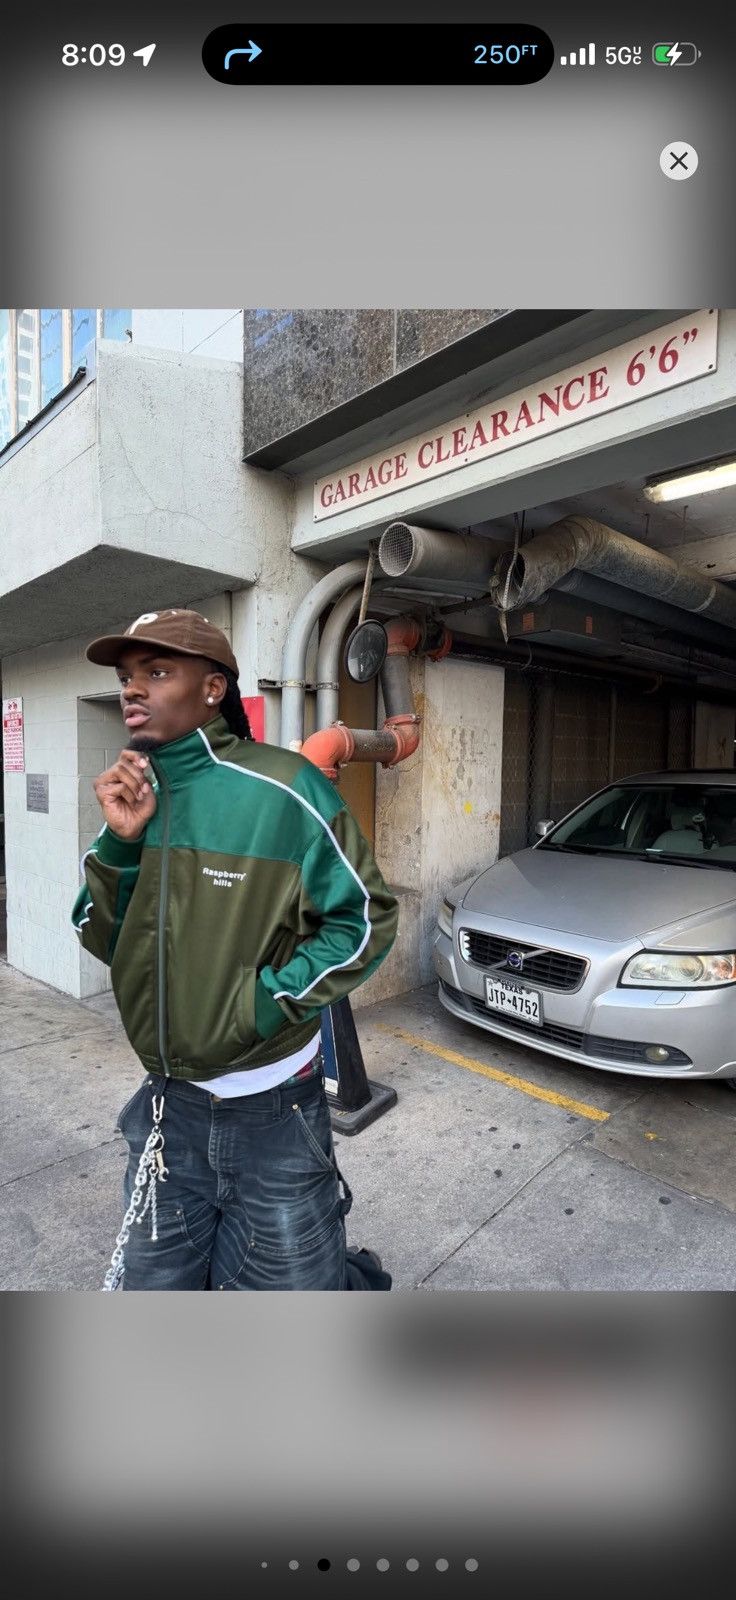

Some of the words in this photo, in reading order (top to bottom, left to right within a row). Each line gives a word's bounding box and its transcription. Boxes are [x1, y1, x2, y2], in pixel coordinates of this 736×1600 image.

[320, 452, 408, 508] GARAGE
[417, 366, 610, 470] CLEARANCE
[202, 867, 247, 881] Raspberry
[213, 878, 232, 887] hills
[501, 982, 523, 995] TEXAS
